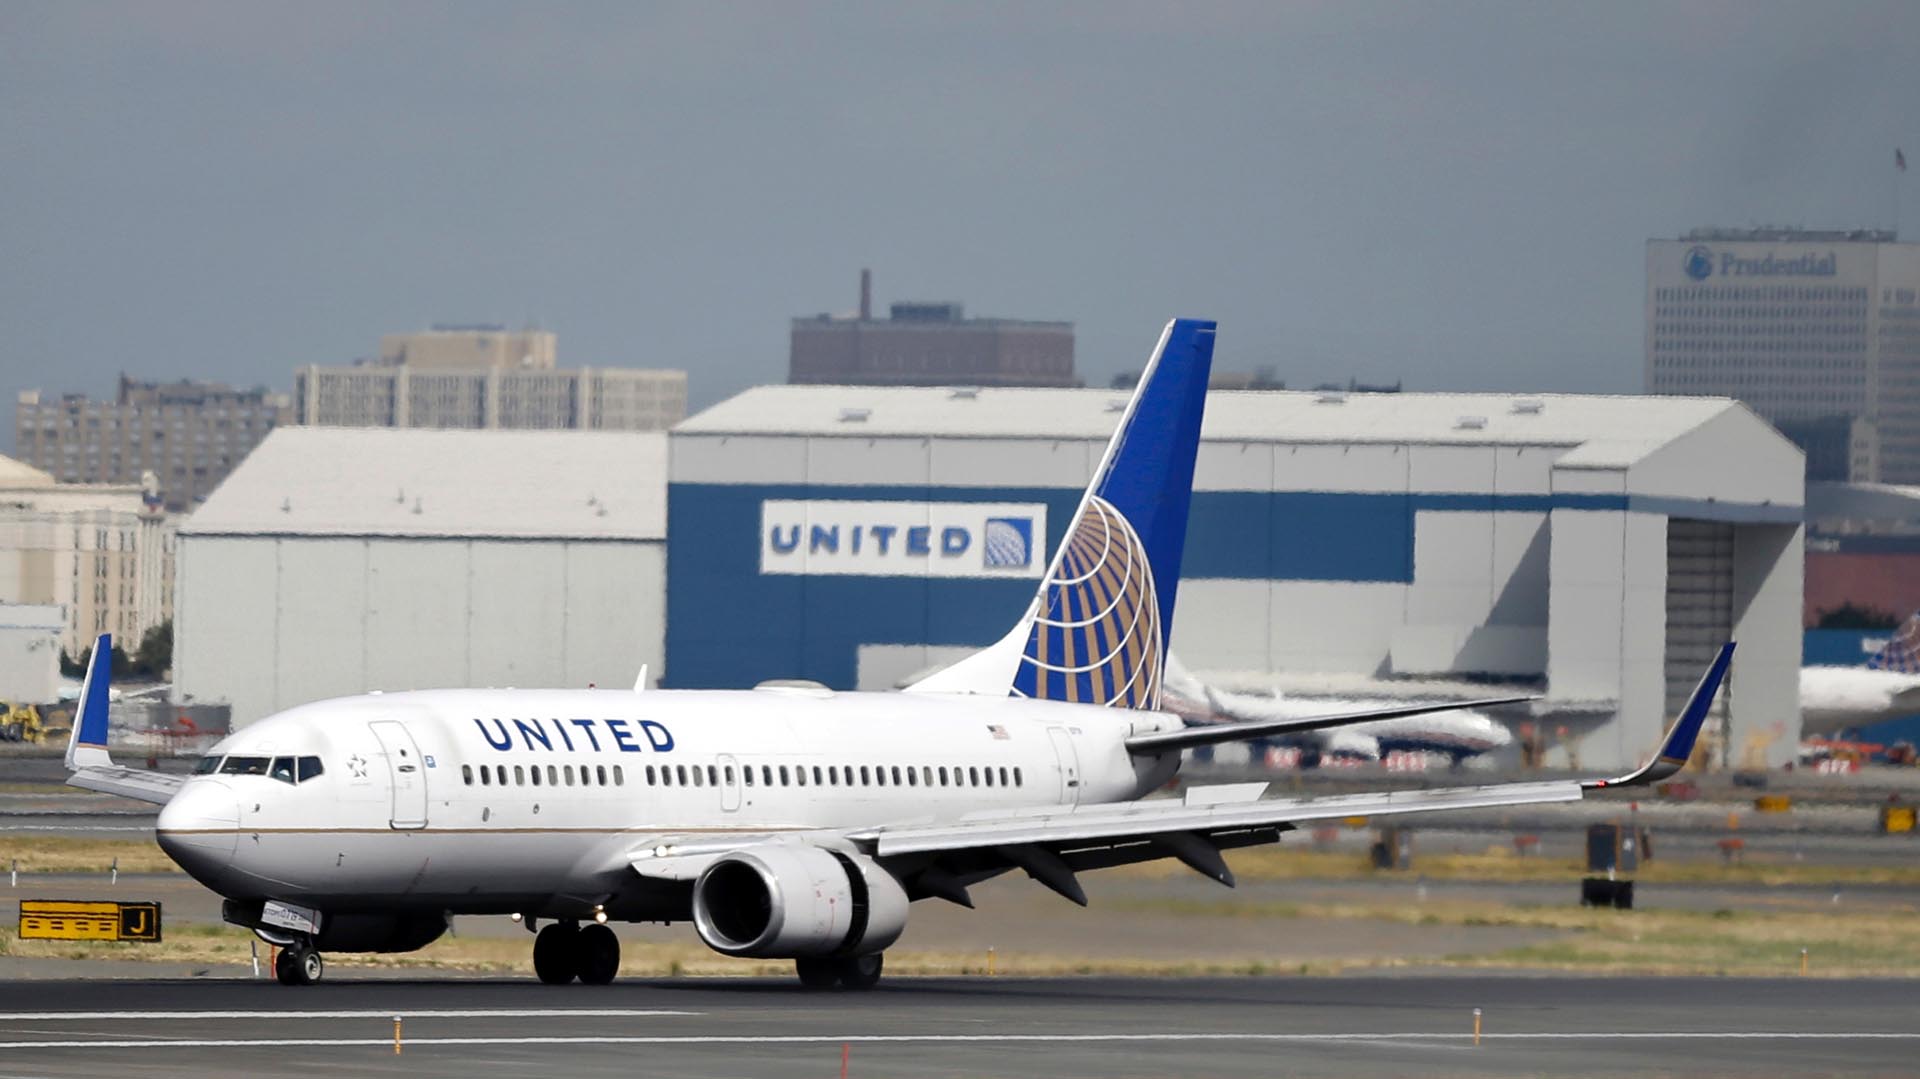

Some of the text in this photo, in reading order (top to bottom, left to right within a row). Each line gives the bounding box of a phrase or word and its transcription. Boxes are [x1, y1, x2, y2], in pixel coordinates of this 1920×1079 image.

[1720, 252, 1836, 276] Prudential
[771, 525, 973, 557] UNITED
[473, 718, 676, 752] UNITED
[130, 911, 146, 934] J
